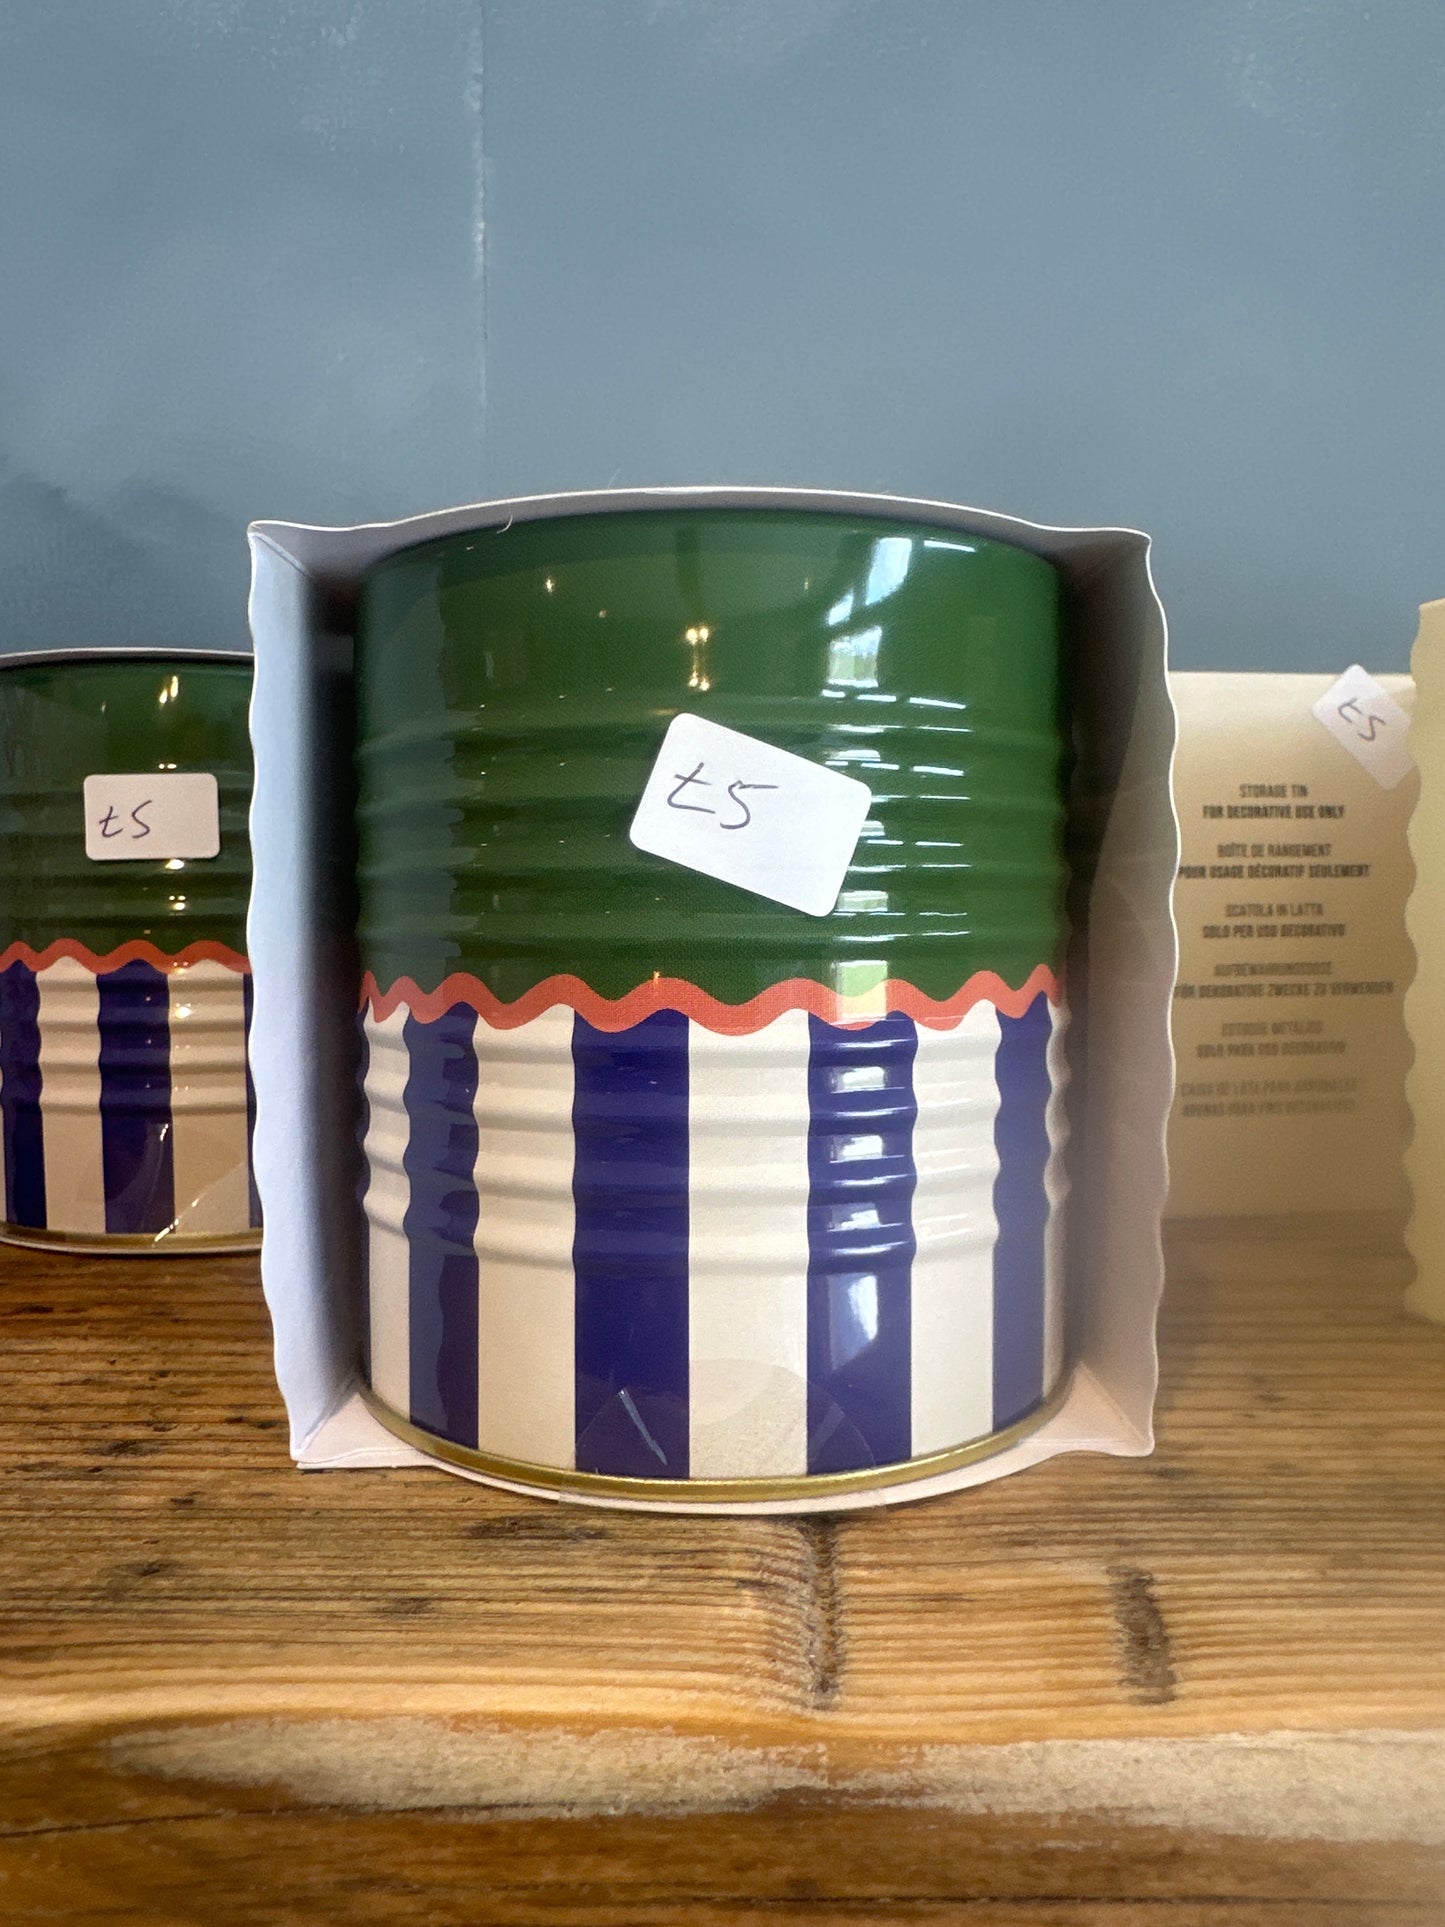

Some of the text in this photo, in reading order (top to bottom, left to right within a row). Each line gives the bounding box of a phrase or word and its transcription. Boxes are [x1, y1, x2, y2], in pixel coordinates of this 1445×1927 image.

[1239, 784, 1288, 798] STORAGE
[1202, 805, 1345, 819] FOR DECORATIVE USE ONLY
[1251, 844, 1265, 857] DE
[1267, 843, 1332, 857] RANGEMENT
